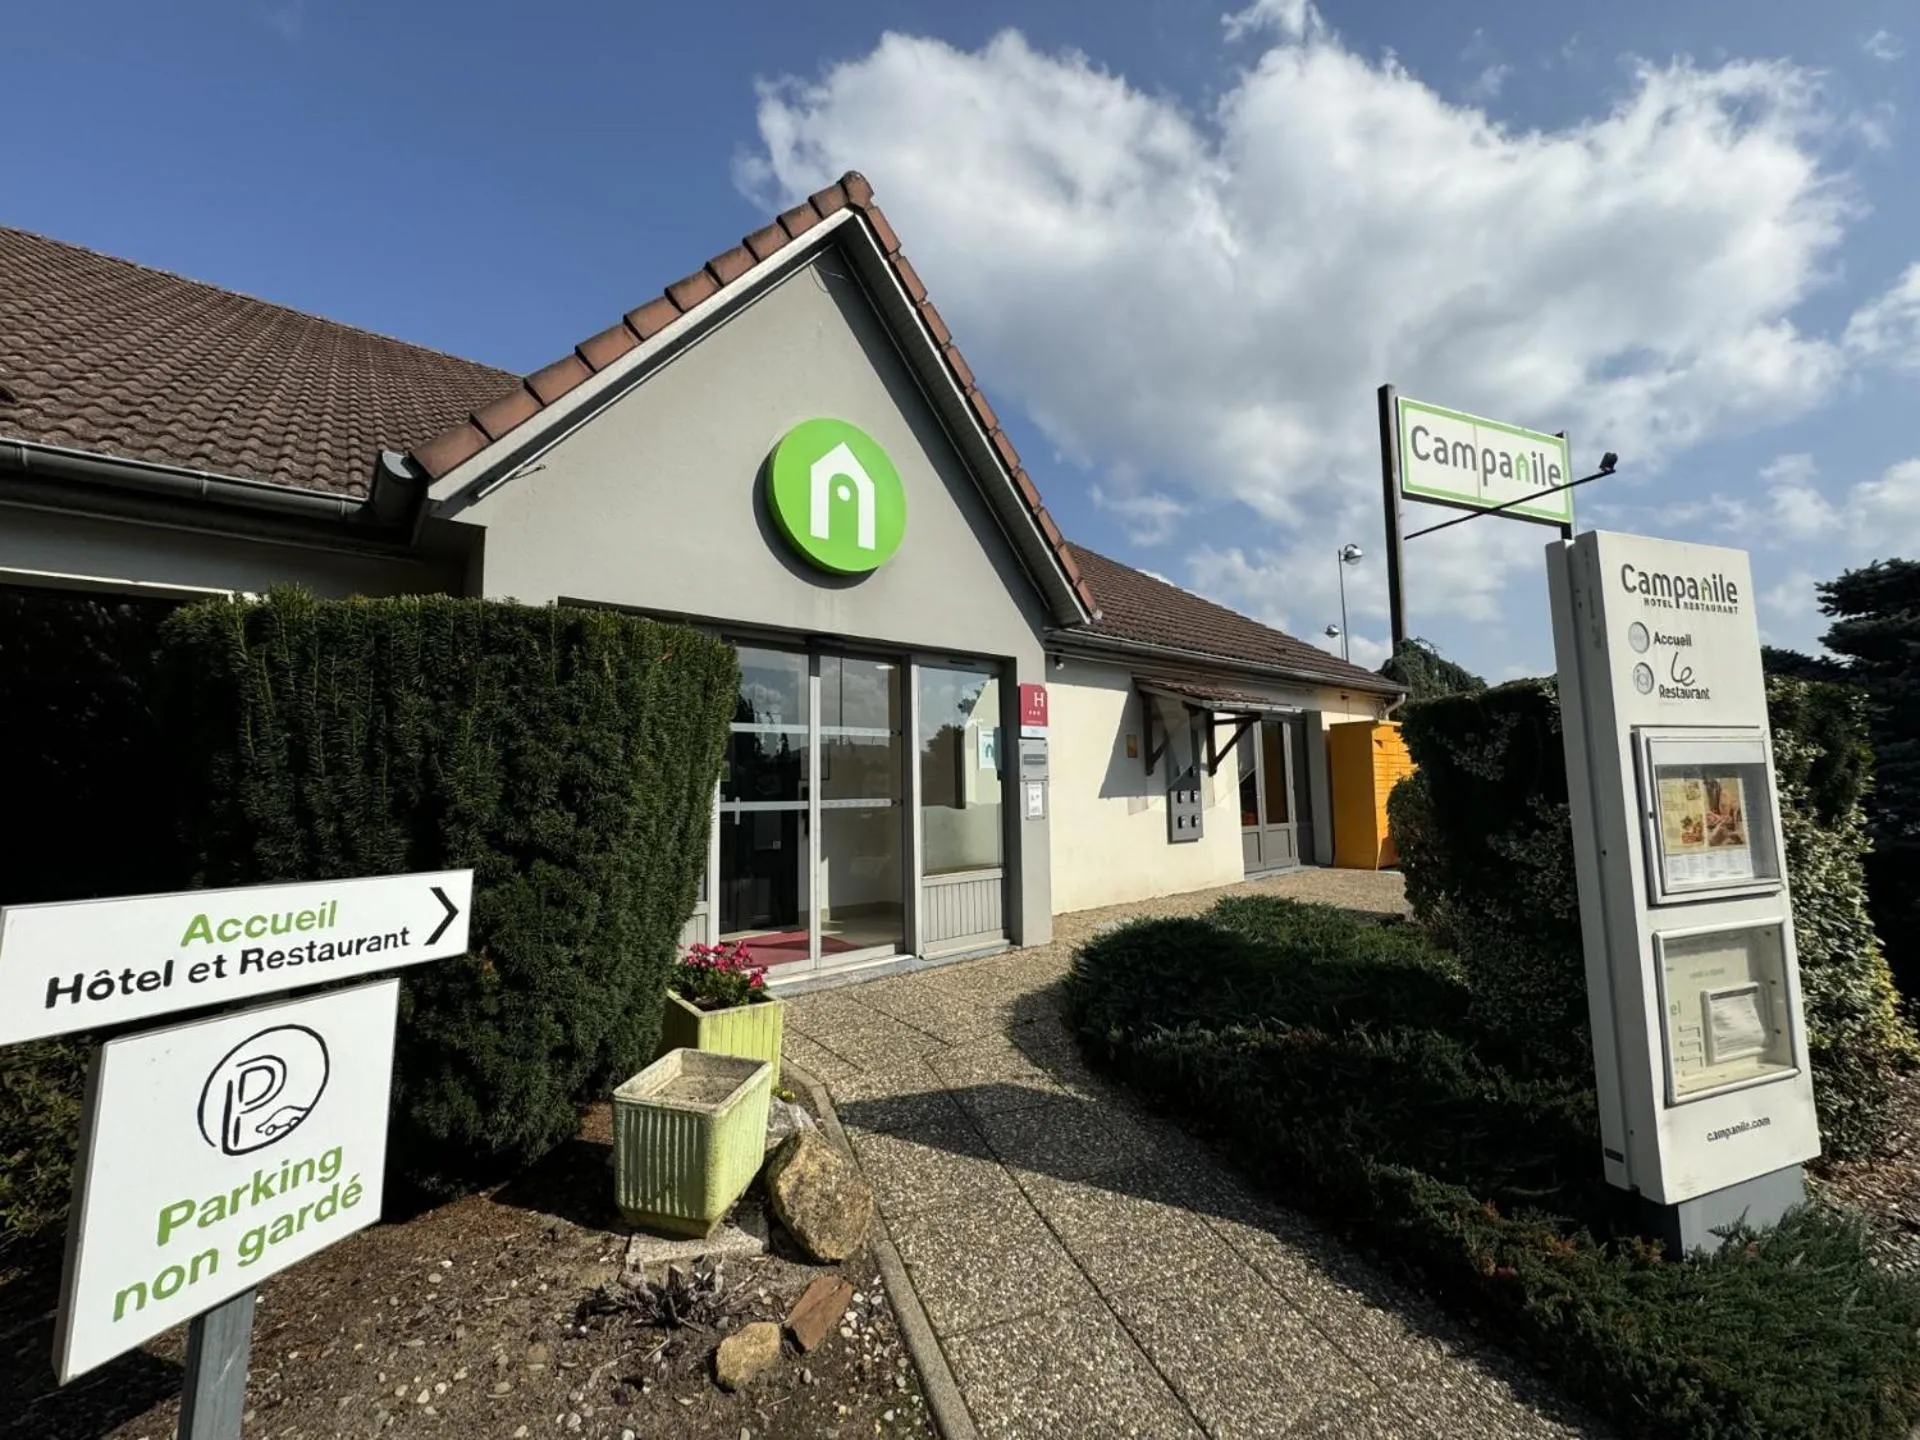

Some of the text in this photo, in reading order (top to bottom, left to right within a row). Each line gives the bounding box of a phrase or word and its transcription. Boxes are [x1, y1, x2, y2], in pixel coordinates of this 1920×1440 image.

[1410, 425, 1562, 488] Campanile
[1620, 563, 1738, 609] Campanile
[1683, 601, 1739, 615] RESTAURANT
[1653, 631, 1692, 647] Accueil
[1033, 691, 1045, 708] H
[1658, 684, 1711, 700] Restaurant
[180, 900, 338, 947] Accueil
[45, 926, 411, 1009] Hôtel et Restaurant
[1706, 1116, 1771, 1142] campanile.com
[156, 1146, 343, 1248] Parking
[112, 1174, 364, 1323] non gardé
